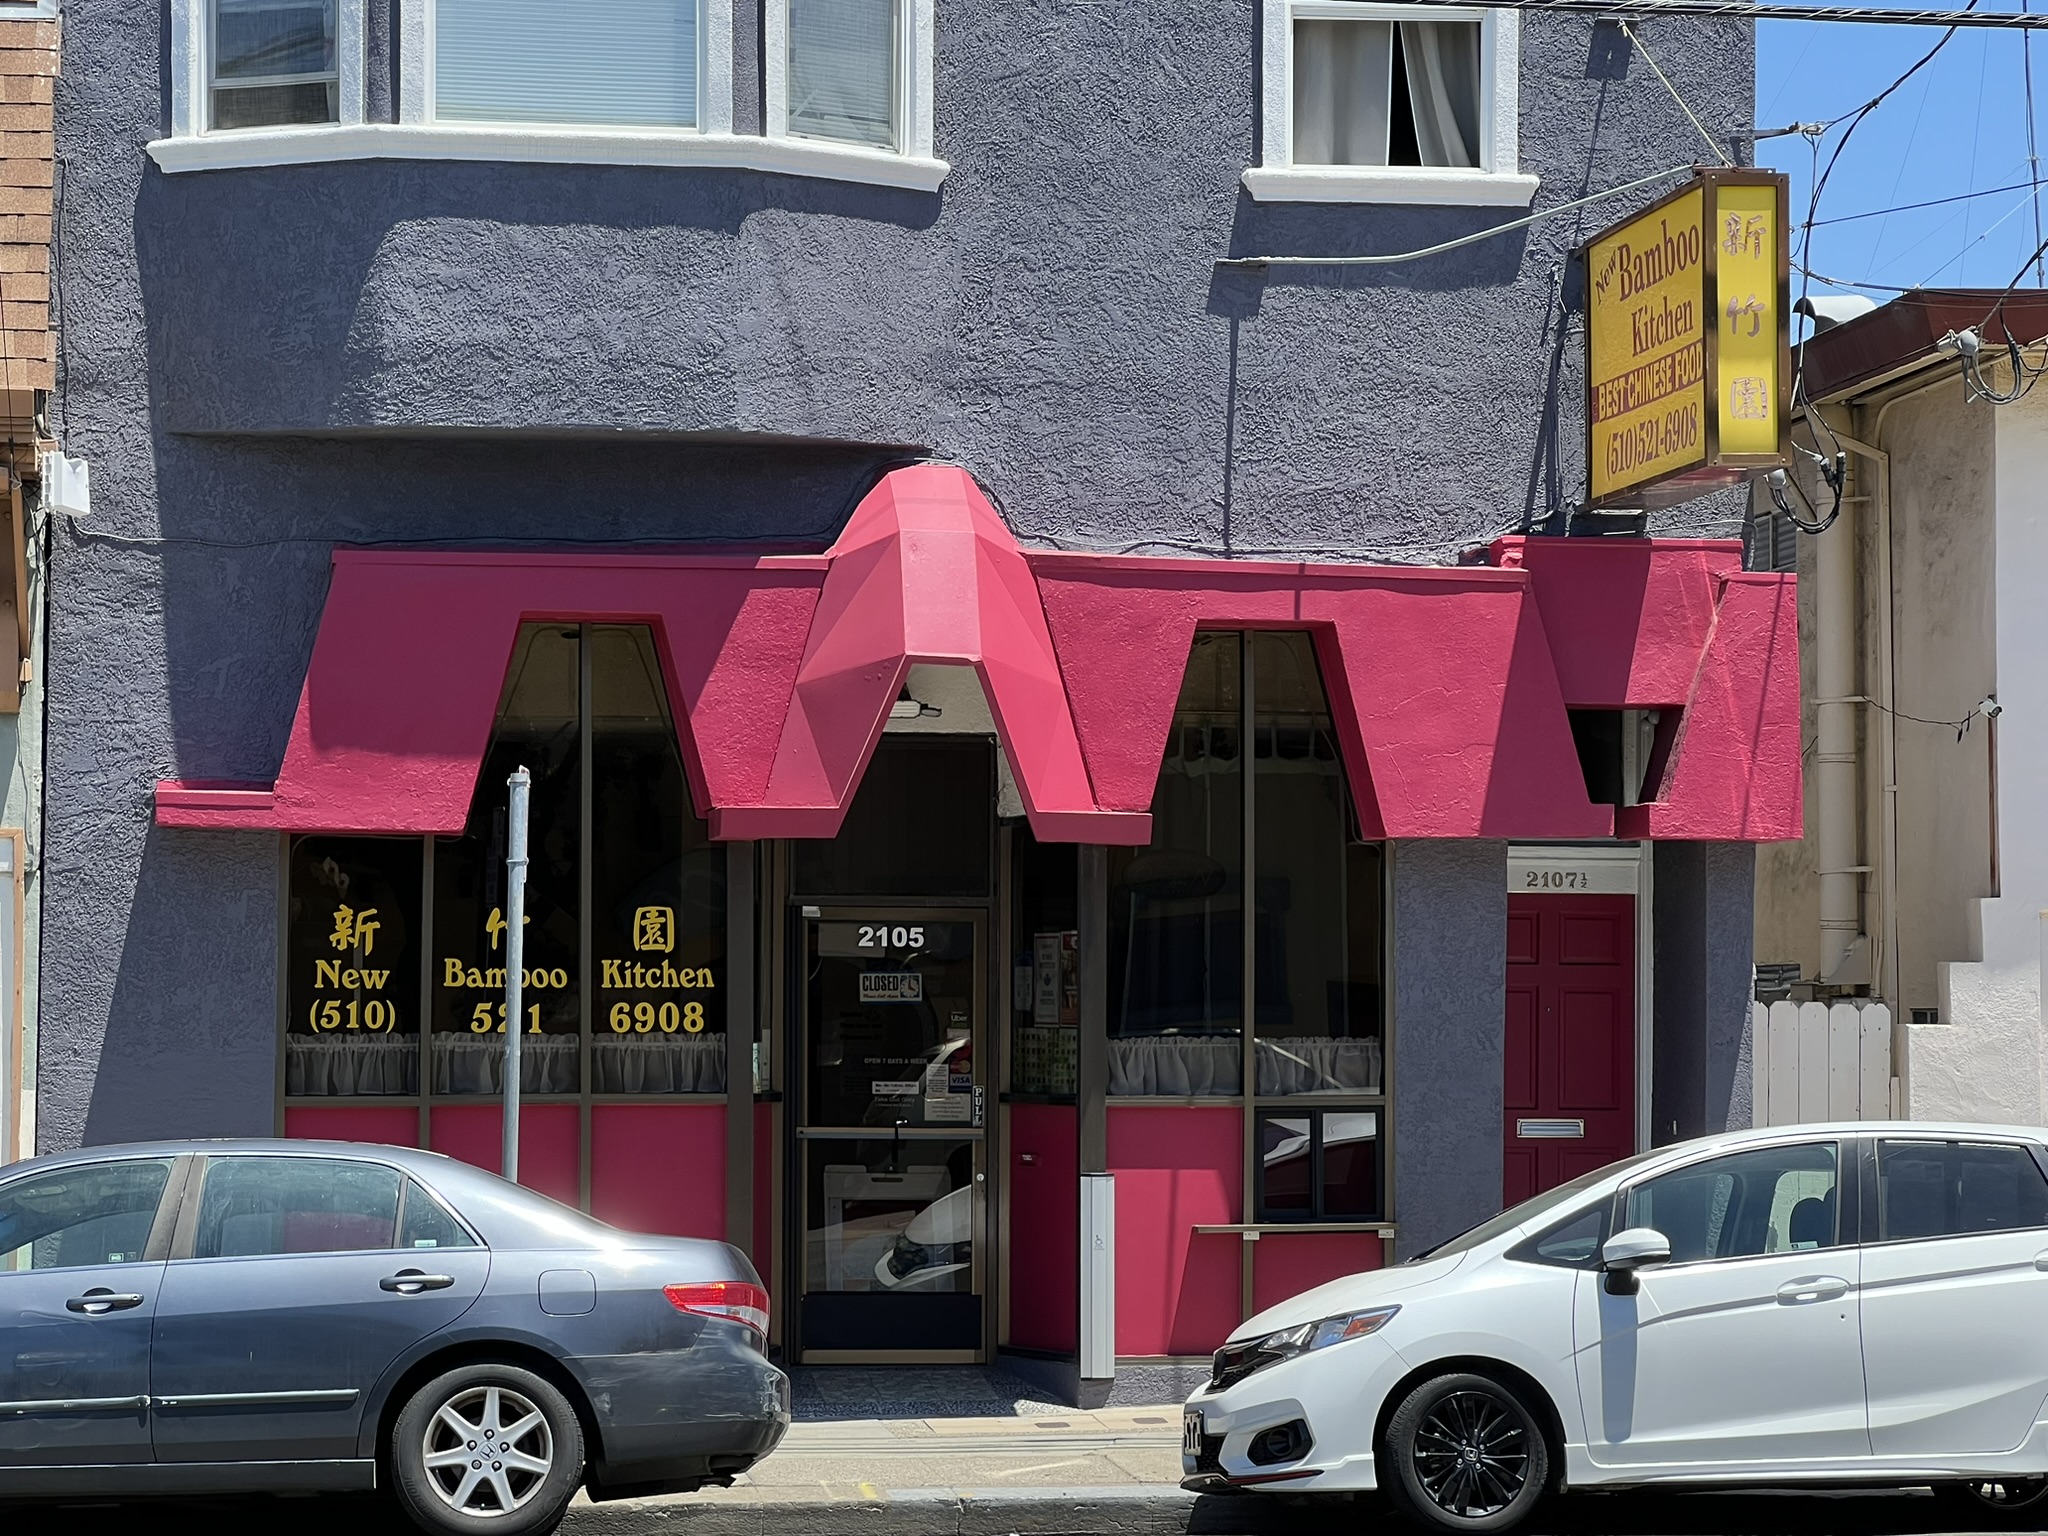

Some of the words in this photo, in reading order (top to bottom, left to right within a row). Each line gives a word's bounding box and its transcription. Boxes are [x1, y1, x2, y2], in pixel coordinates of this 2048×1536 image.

[1595, 250, 1616, 306] New
[1617, 219, 1700, 302] Bamboo
[1631, 296, 1694, 357] Kitchen
[1599, 377, 1626, 420] BEST
[1627, 356, 1673, 409] CHINESE
[1675, 342, 1704, 390] FOOD
[1606, 402, 1697, 481] (510)521-6908
[329, 904, 380, 956] 新
[633, 906, 675, 953] 園
[858, 926, 925, 948] 2105
[314, 959, 390, 990] New
[601, 959, 715, 989] Kitchen
[862, 975, 899, 992] CLOSED
[309, 998, 397, 1034] (510)
[609, 1002, 705, 1034] 6908
[951, 1014, 968, 1022] Uber
